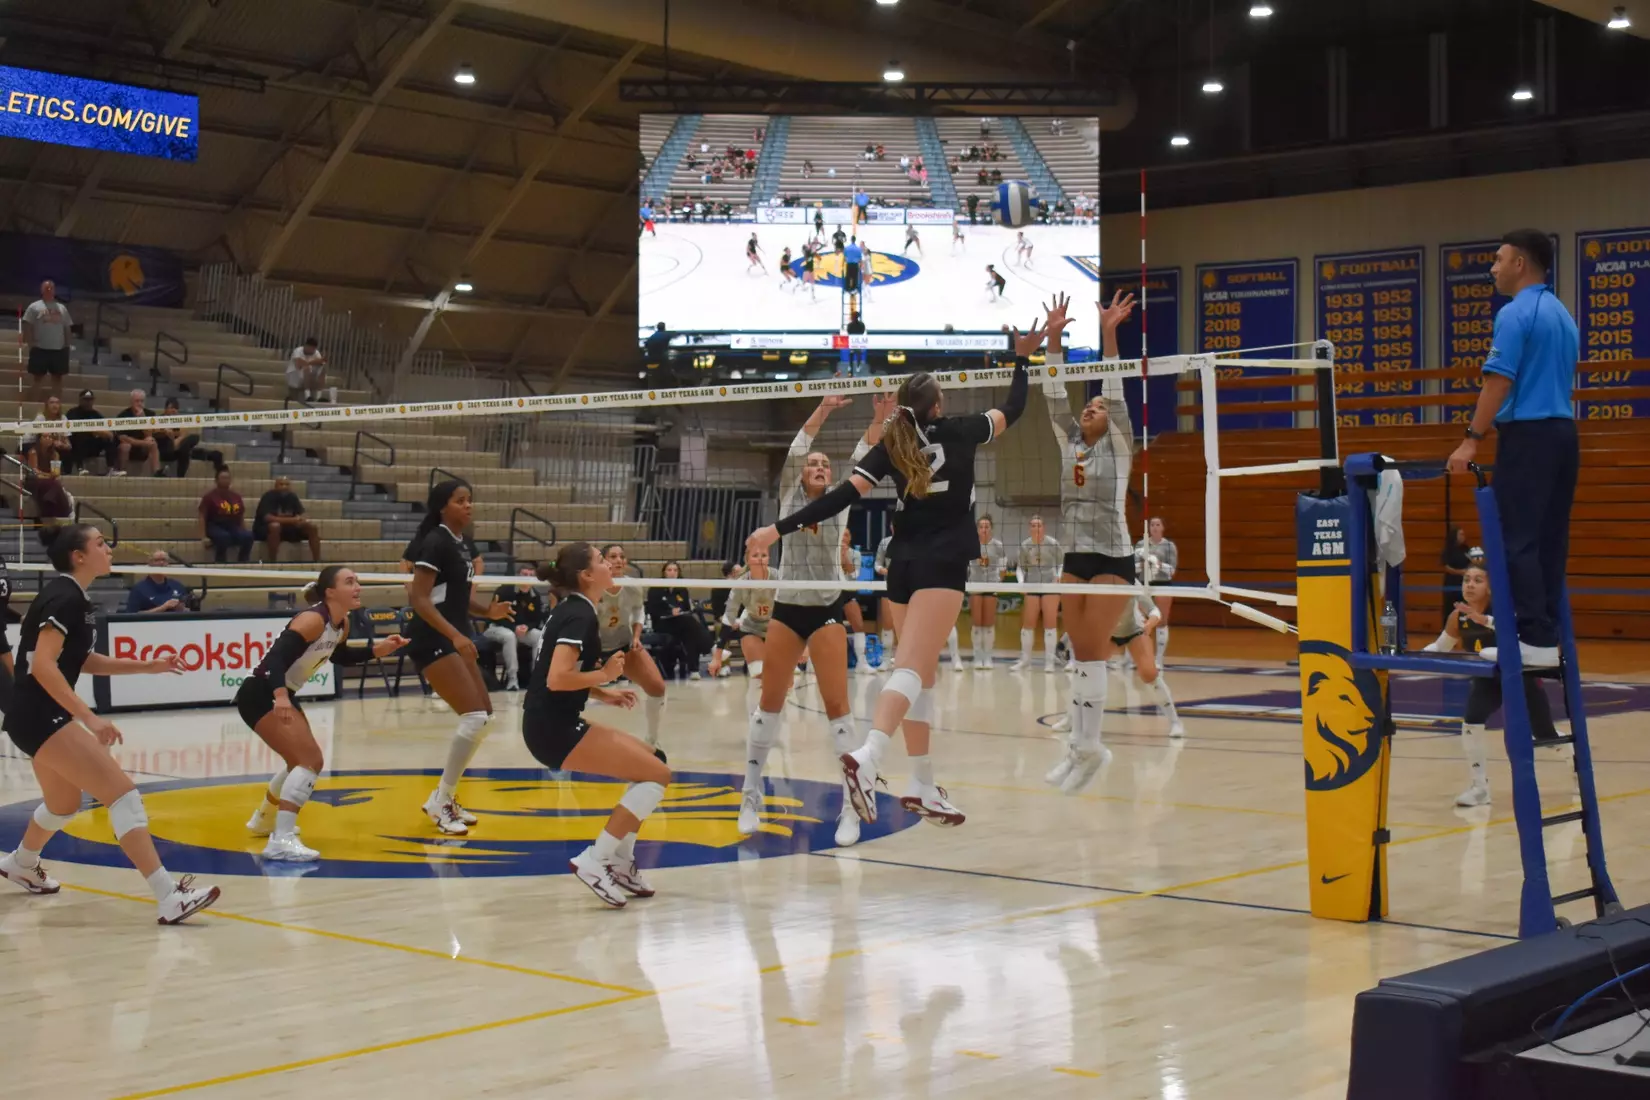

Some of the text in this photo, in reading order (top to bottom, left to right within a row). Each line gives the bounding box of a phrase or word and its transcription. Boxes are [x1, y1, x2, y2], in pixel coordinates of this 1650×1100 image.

[1340, 259, 1418, 275] FOOTBALL
[1227, 271, 1287, 284] SOFTBALL
[1588, 273, 1635, 289] 1990
[1372, 289, 1412, 305] 1952
[1452, 284, 1494, 299] 1969
[1325, 293, 1364, 308] 1933
[1588, 292, 1629, 308] 1991
[1204, 301, 1241, 316] 2016
[1372, 306, 1412, 323] 1953
[1452, 301, 1491, 317] 1972
[1204, 318, 1240, 333] 2018
[1325, 311, 1364, 326] 1934
[1588, 310, 1634, 327] 1995
[1325, 328, 1364, 342] 1935
[1372, 324, 1412, 339] 1954
[1452, 320, 1493, 335] 1983
[1204, 335, 1241, 349] 2019
[1452, 337, 1492, 353] 1990
[1588, 329, 1633, 346] 2015
[1334, 345, 1364, 359] 937
[1372, 342, 1413, 357] 1955
[1588, 348, 1634, 361] 2016
[974, 369, 1041, 380] EAST TEX &M
[1065, 366, 1086, 375] EAST
[1089, 364, 1115, 373] TEXAS
[808, 383, 826, 391] EAST
[829, 382, 851, 390] TEXAS
[1588, 405, 1633, 420] 2019
[1073, 464, 1086, 488] 6
[1316, 519, 1340, 528] EAST
[1313, 531, 1343, 540] TEXAS
[1312, 542, 1345, 556] A&M
[220, 673, 243, 687] foo
